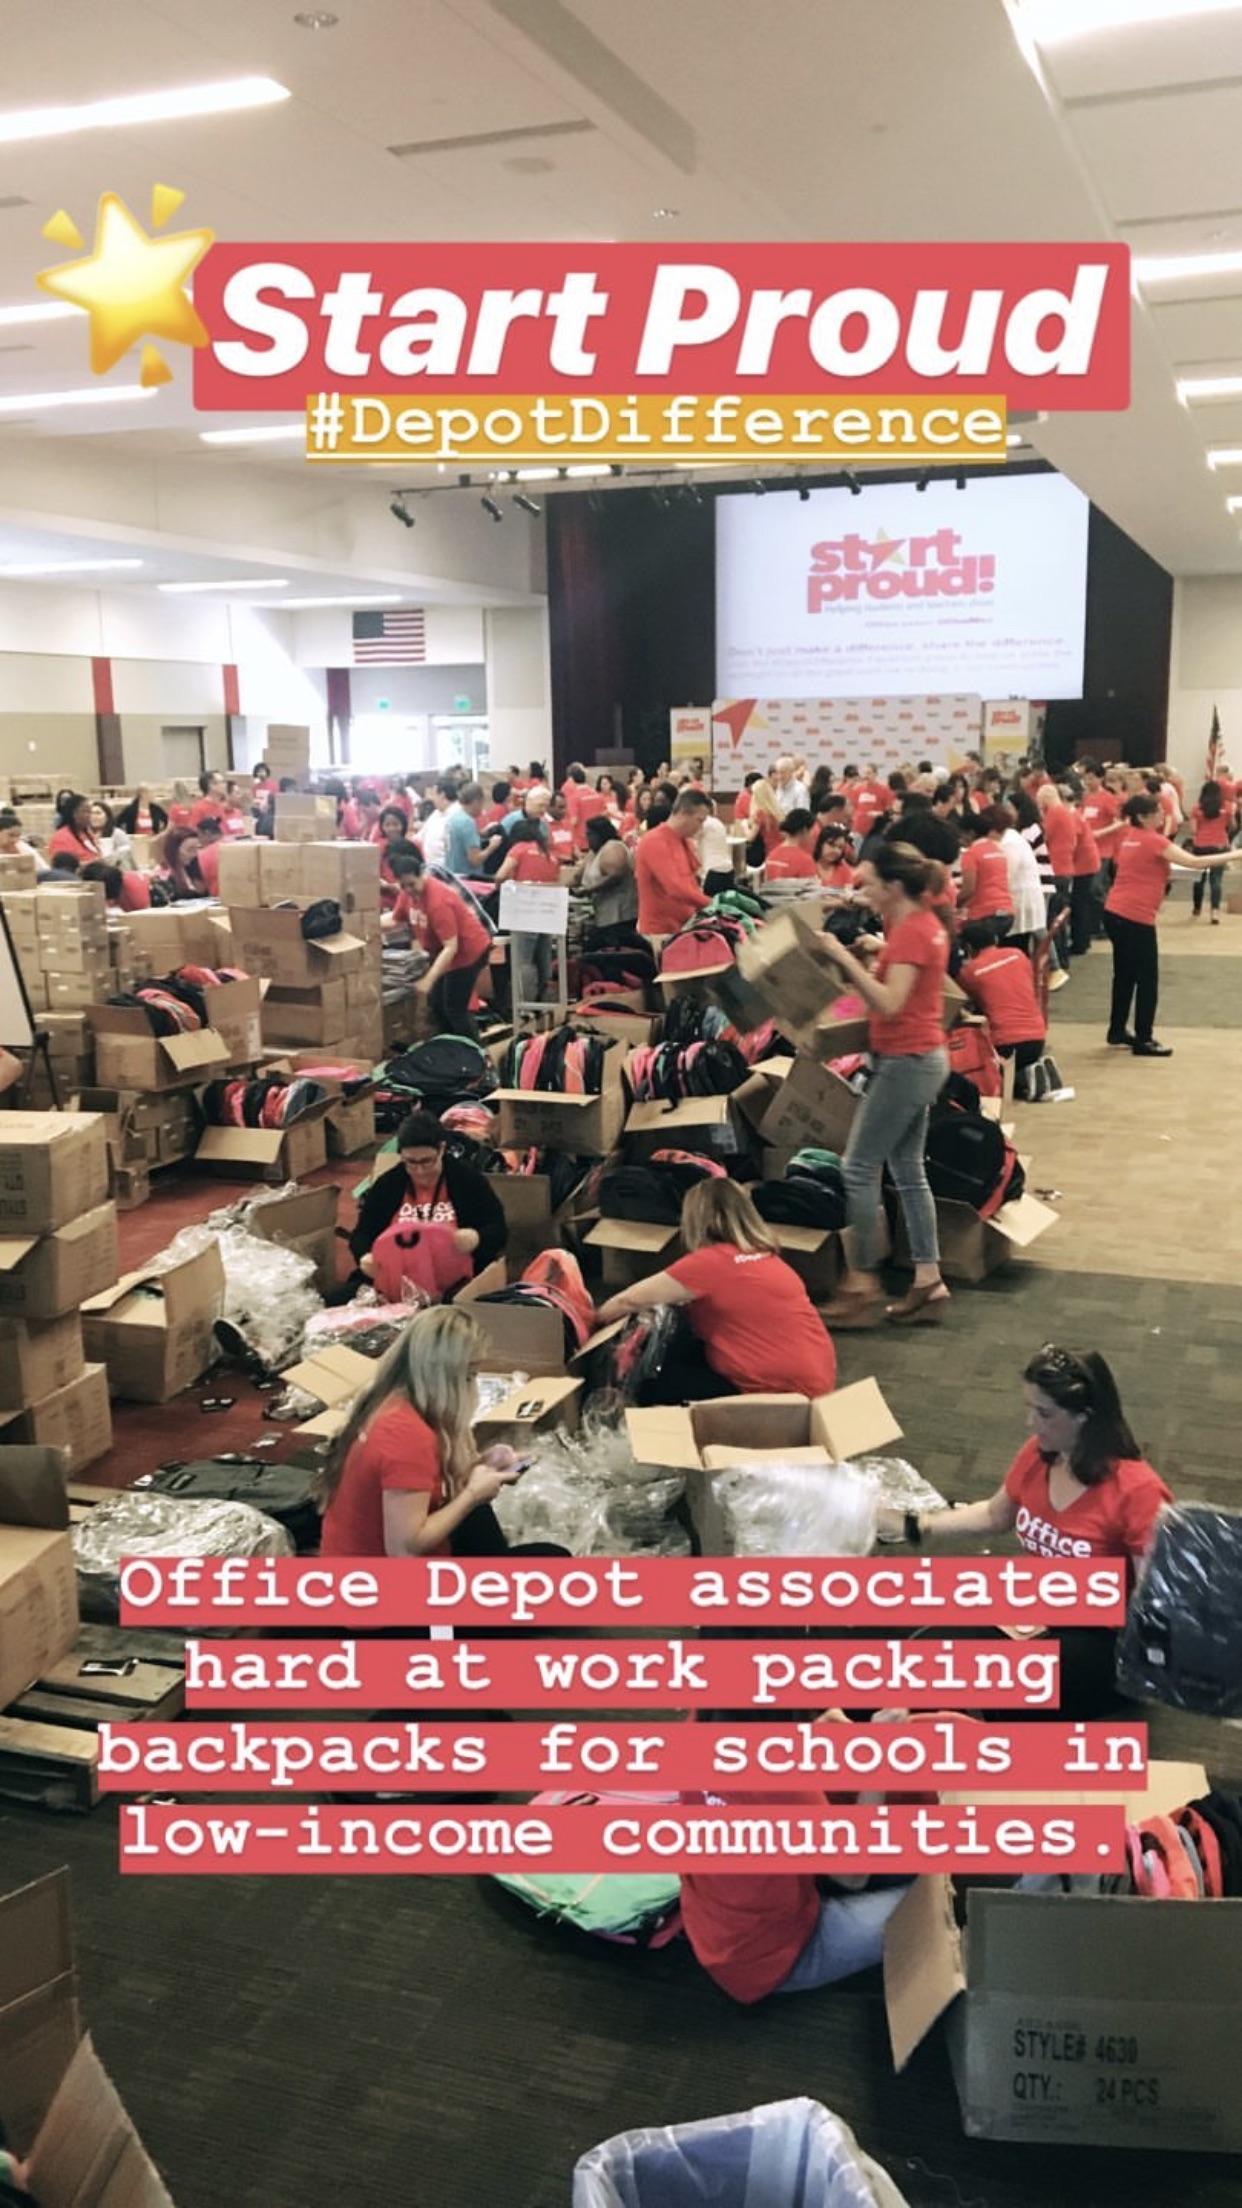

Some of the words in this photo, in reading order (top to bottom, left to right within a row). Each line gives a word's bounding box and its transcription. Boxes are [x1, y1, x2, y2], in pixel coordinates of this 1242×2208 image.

[807, 554, 995, 614] proud!
[1016, 1506, 1092, 1558] Office
[1014, 2029, 1087, 2063] STYLE#
[1096, 2077, 1117, 2103] 24
[1122, 2078, 1160, 2105] PCS
